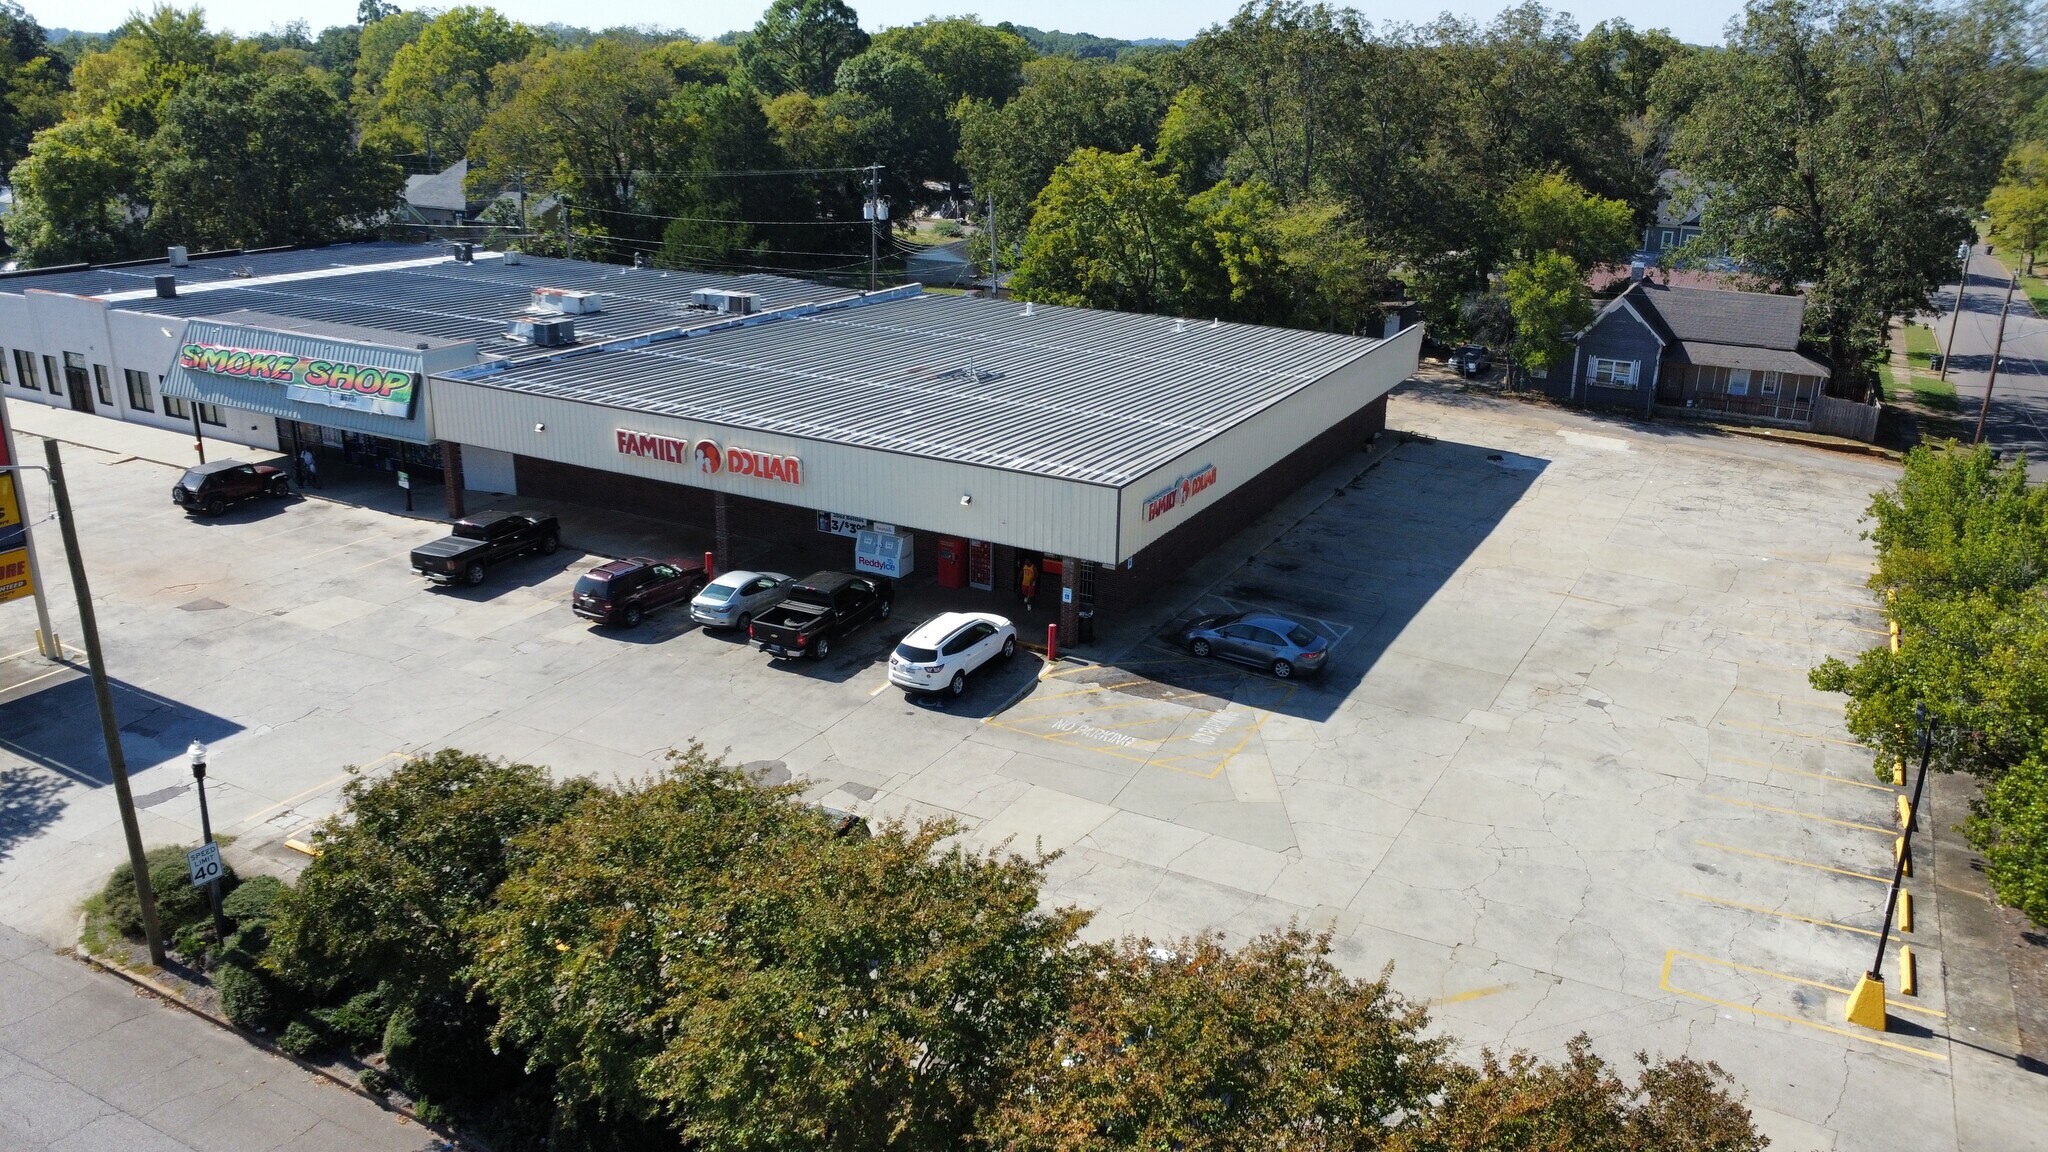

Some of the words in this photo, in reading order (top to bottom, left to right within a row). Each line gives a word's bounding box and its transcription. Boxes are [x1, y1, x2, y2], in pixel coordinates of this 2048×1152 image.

[181, 343, 299, 382] SMOKE
[304, 359, 409, 398] SHOP
[617, 431, 686, 464] FAMILY
[727, 449, 800, 485] DOLLAR
[1148, 489, 1178, 522] FAMILY
[1191, 465, 1217, 497] DOLLAR
[1052, 718, 1076, 731] NO
[1073, 724, 1138, 748] PARKING
[191, 847, 215, 861] SPEED
[195, 855, 214, 867] LIMIT
[194, 862, 218, 879] 40
